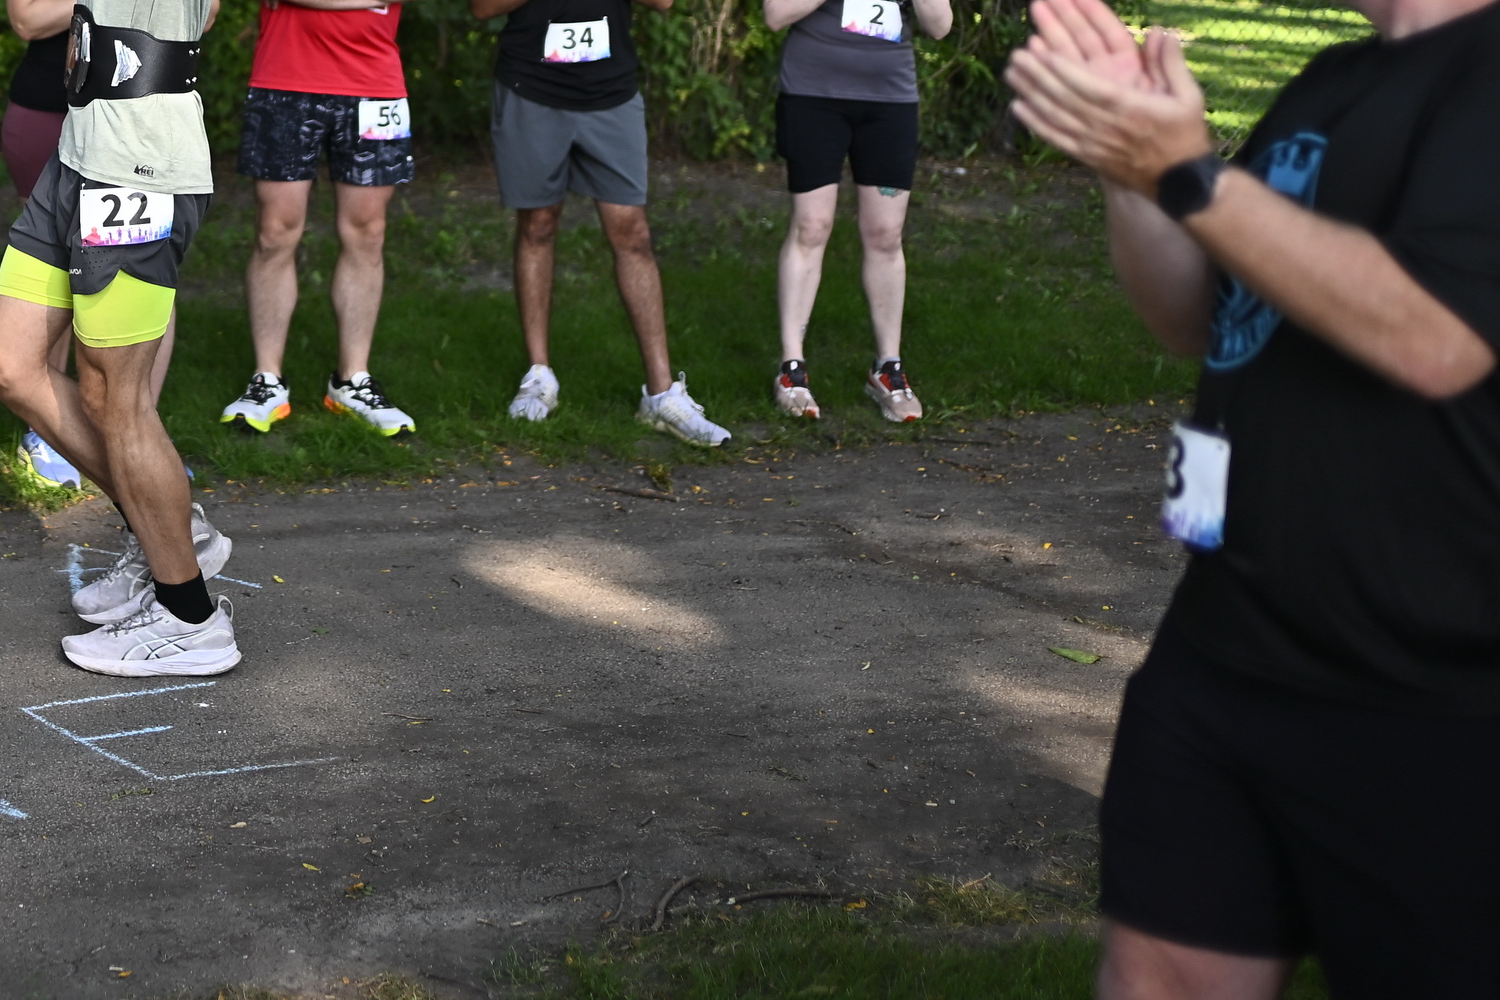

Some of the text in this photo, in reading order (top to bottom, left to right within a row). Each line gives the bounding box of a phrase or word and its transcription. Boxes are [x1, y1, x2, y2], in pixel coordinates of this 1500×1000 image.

[869, 4, 885, 26] 2
[562, 27, 594, 50] 34
[377, 104, 401, 127] 56
[101, 192, 151, 228] 22
